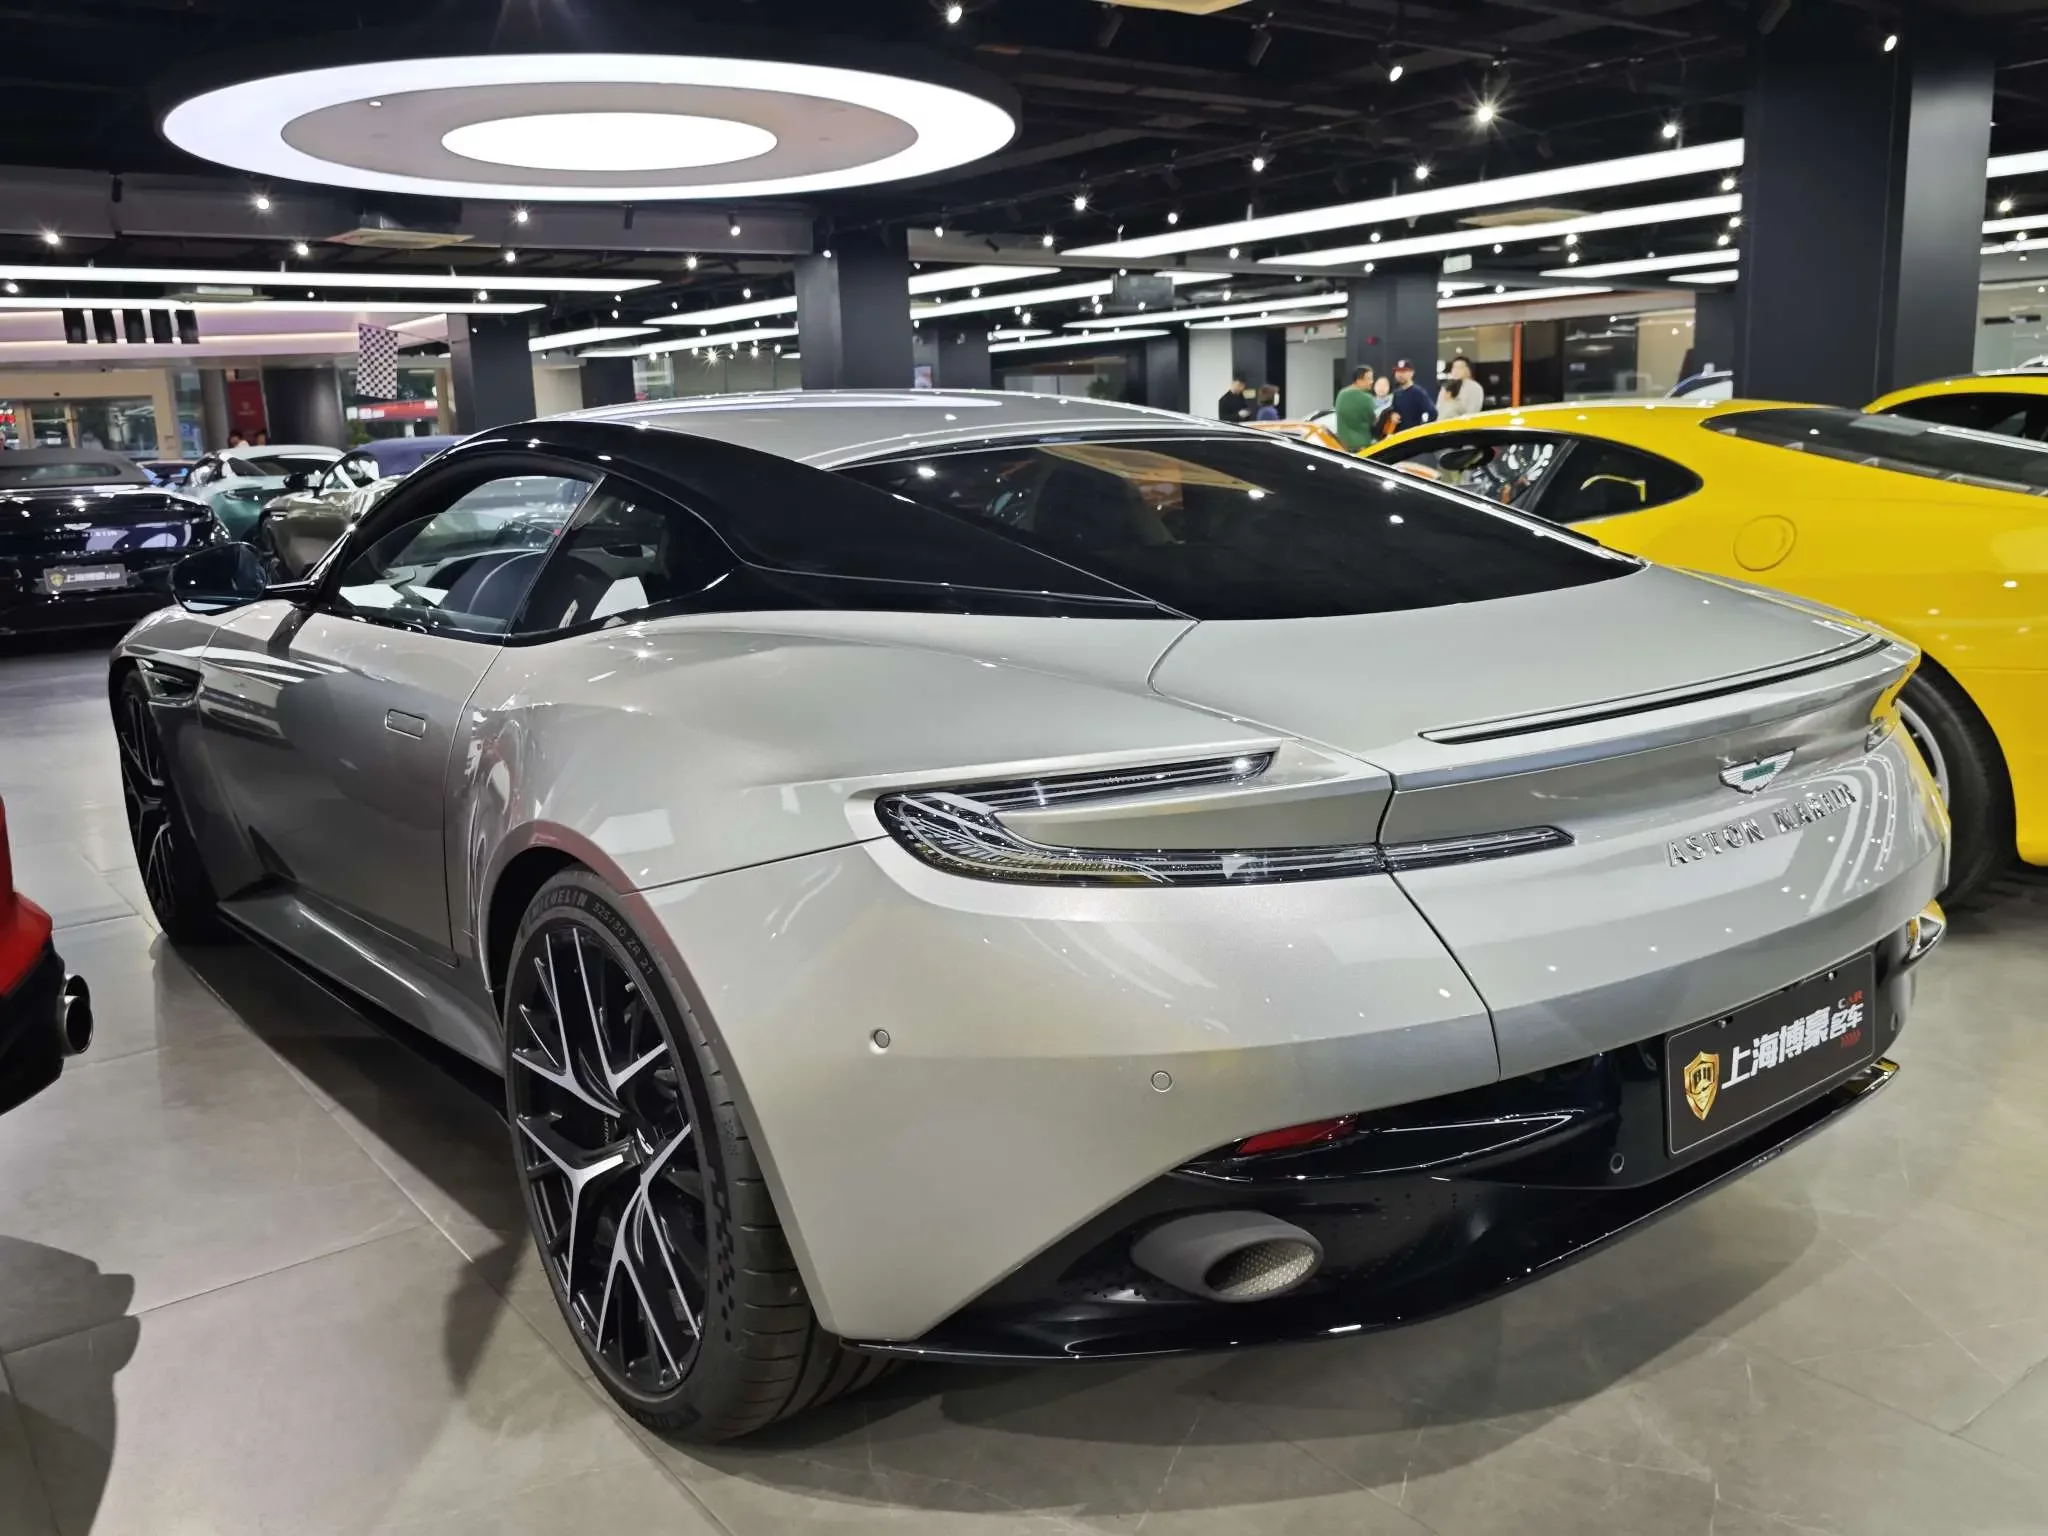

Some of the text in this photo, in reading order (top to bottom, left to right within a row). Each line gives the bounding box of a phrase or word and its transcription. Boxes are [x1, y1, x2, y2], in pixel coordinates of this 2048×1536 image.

[1667, 817, 1765, 867] ASTON
[529, 888, 589, 924] MICHELIN
[592, 901, 627, 937] 325/30
[639, 958, 654, 975] 21
